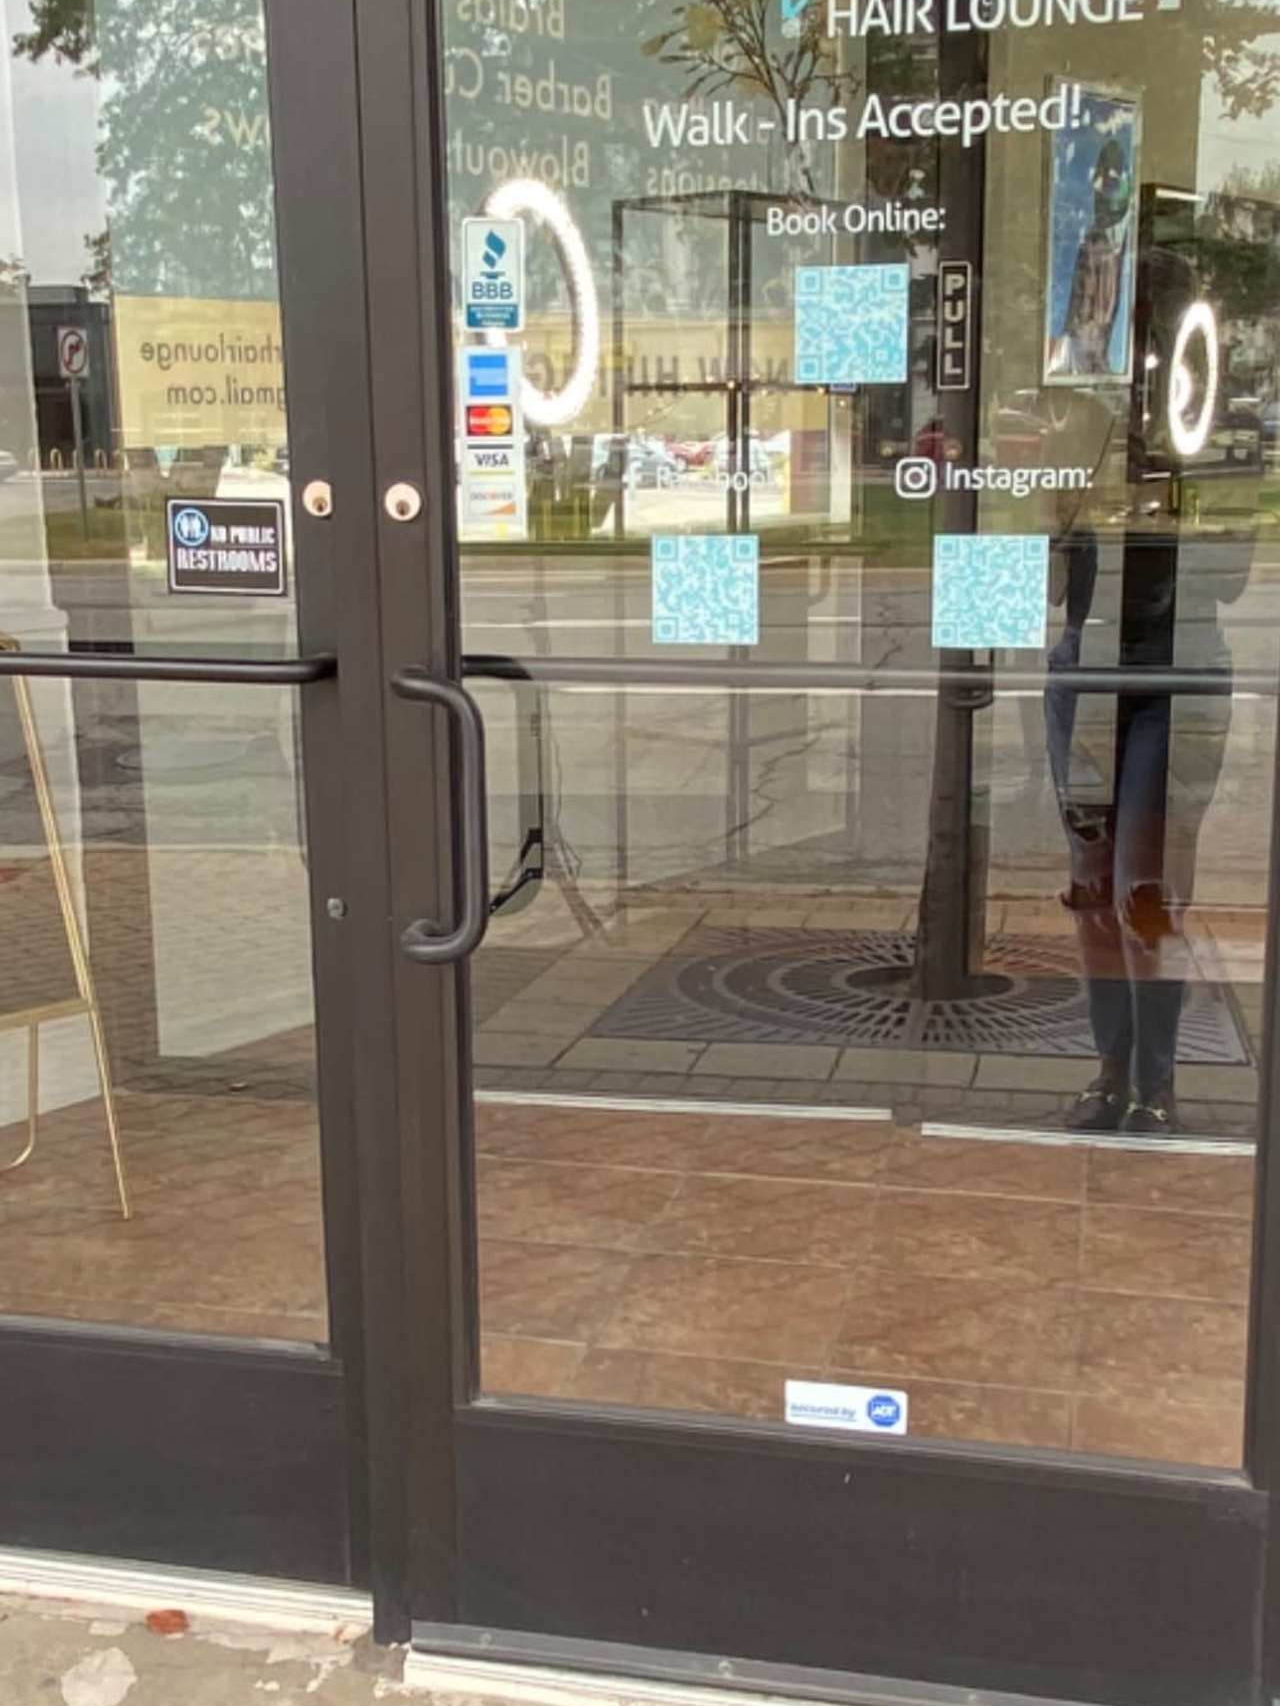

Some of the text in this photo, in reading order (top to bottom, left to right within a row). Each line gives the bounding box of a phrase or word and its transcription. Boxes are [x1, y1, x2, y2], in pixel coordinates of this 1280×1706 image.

[642, 99, 749, 149] Walk
[786, 98, 847, 143] Ins
[856, 83, 1083, 148] Accepted!
[766, 203, 947, 236] Book Online:
[471, 280, 514, 301] BBB
[943, 272, 966, 375] PULL
[474, 452, 510, 468] VISA
[944, 461, 1094, 497] Instagram:
[230, 525, 276, 544] PUBLIC
[176, 547, 278, 573] RESTROOMS
